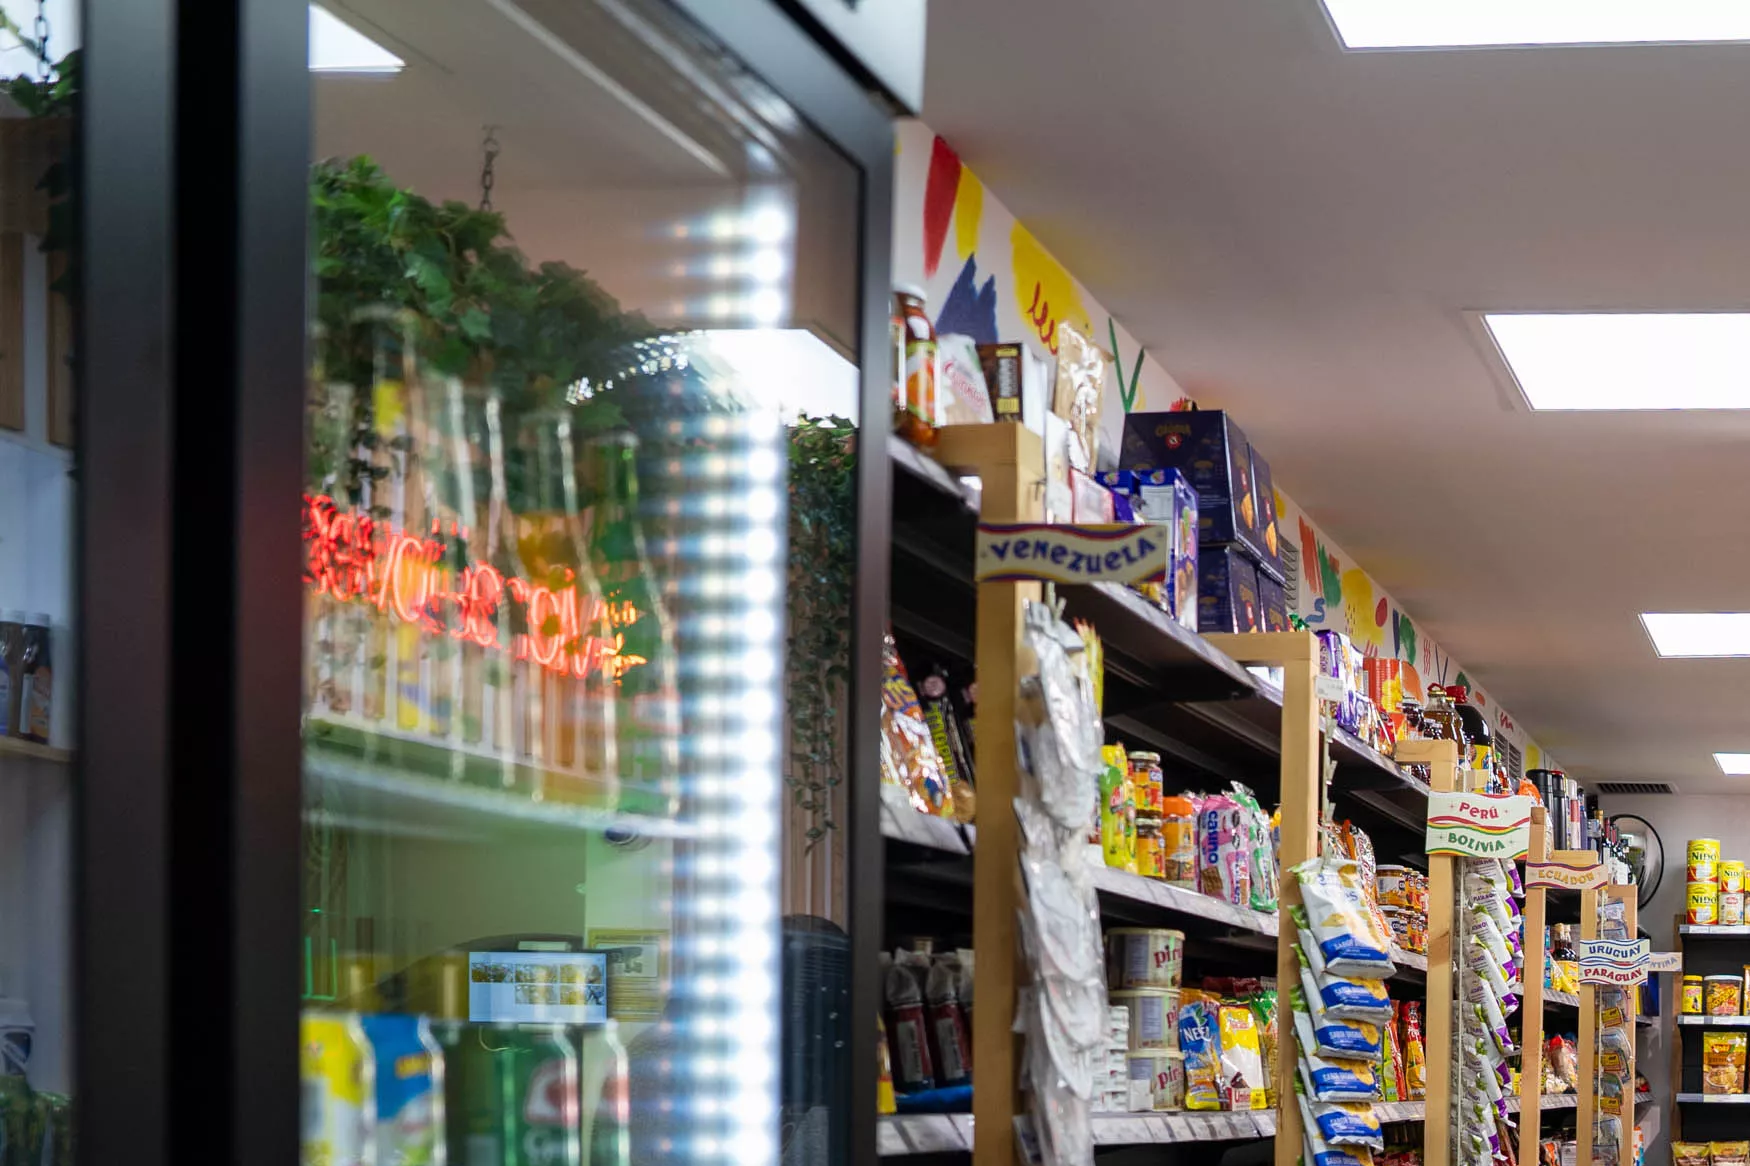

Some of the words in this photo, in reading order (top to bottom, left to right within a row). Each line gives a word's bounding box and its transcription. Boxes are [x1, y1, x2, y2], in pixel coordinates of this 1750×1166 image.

[990, 536, 1157, 575] VENEZUELA
[1458, 802, 1499, 819] PERÚ
[1448, 832, 1505, 852] BOLIVIA
[1691, 851, 1717, 861] NIDO
[1538, 869, 1595, 885] ECUADOR
[1691, 895, 1718, 904] NIDO
[1588, 945, 1641, 959] URUGUAY
[1583, 967, 1643, 982] PARAGUAY
